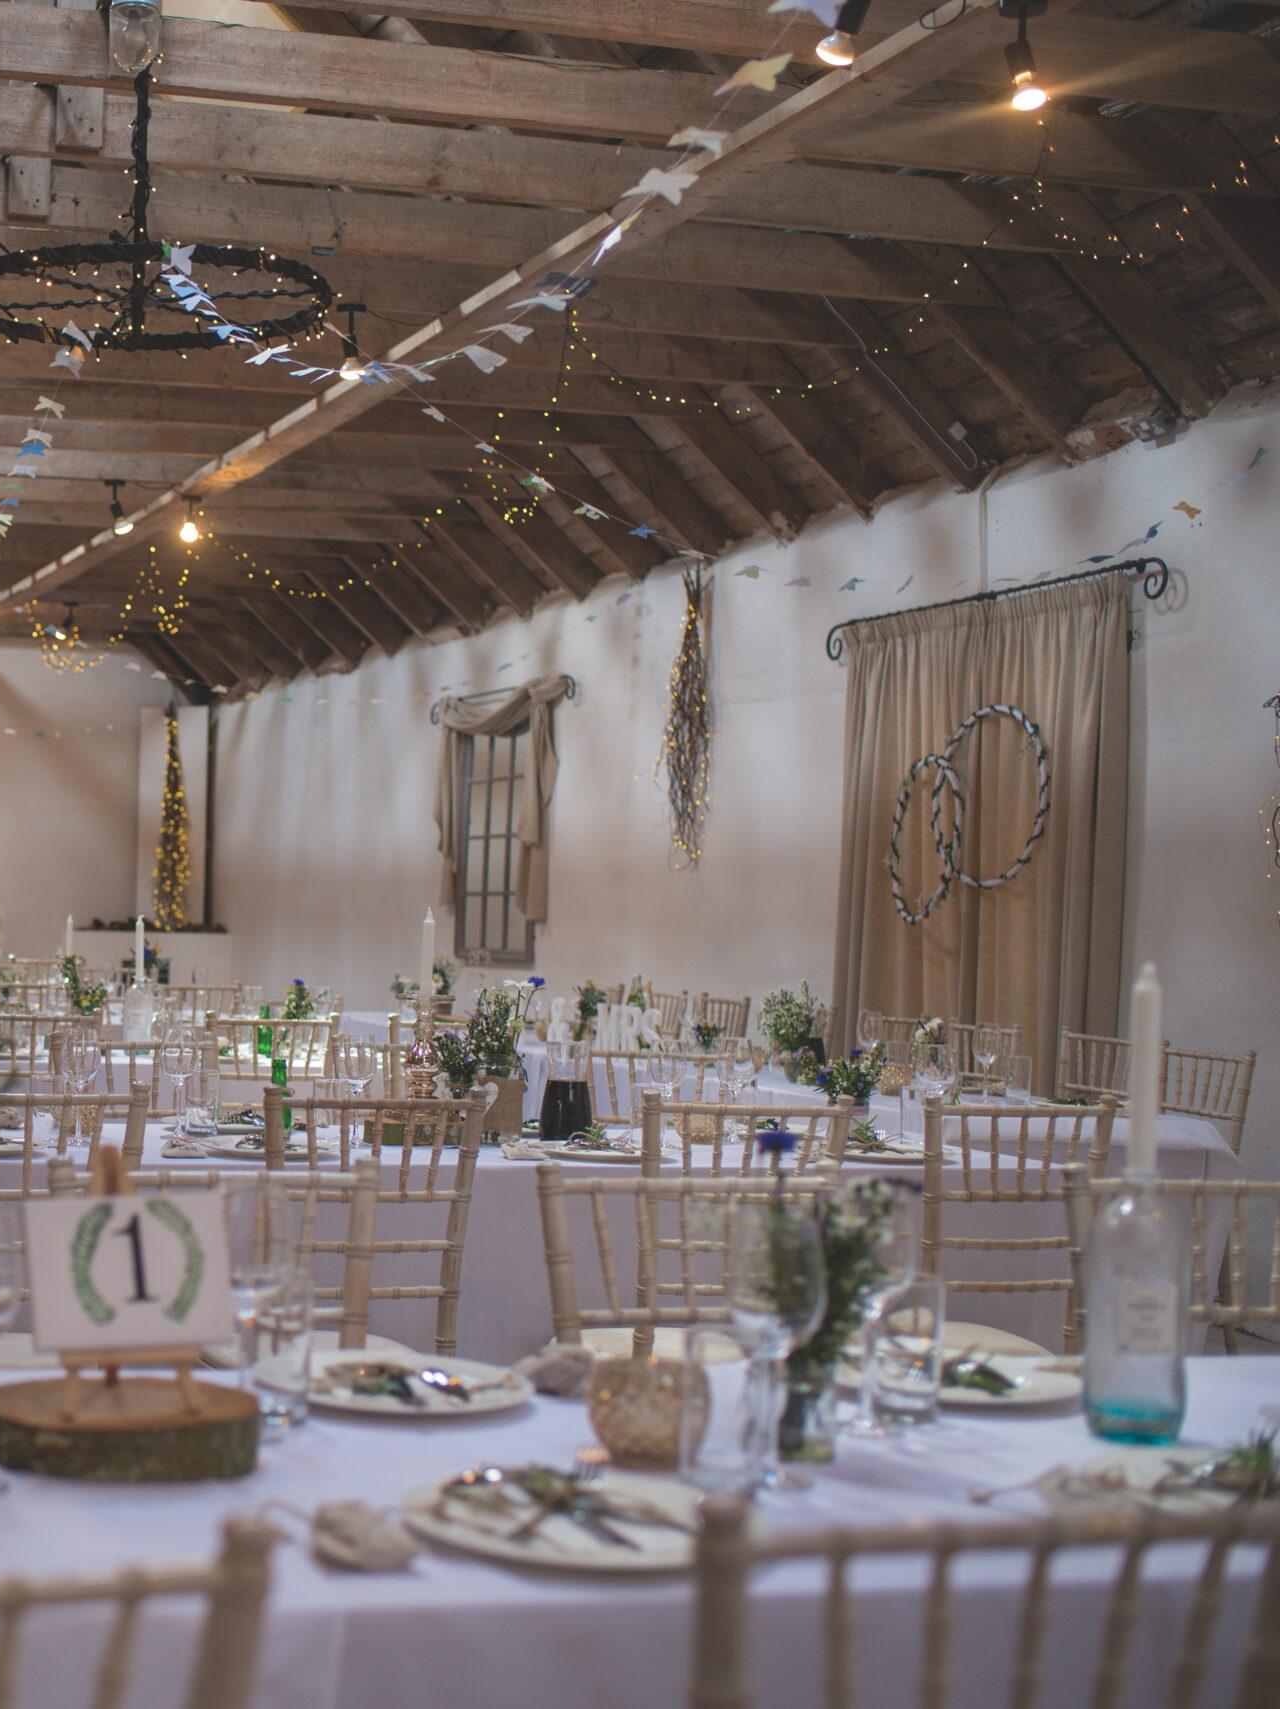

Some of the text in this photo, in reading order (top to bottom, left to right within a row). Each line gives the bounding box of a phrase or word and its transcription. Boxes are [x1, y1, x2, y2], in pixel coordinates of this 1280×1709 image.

[546, 997, 664, 1051] & MRS
[111, 1212, 162, 1304] 1
